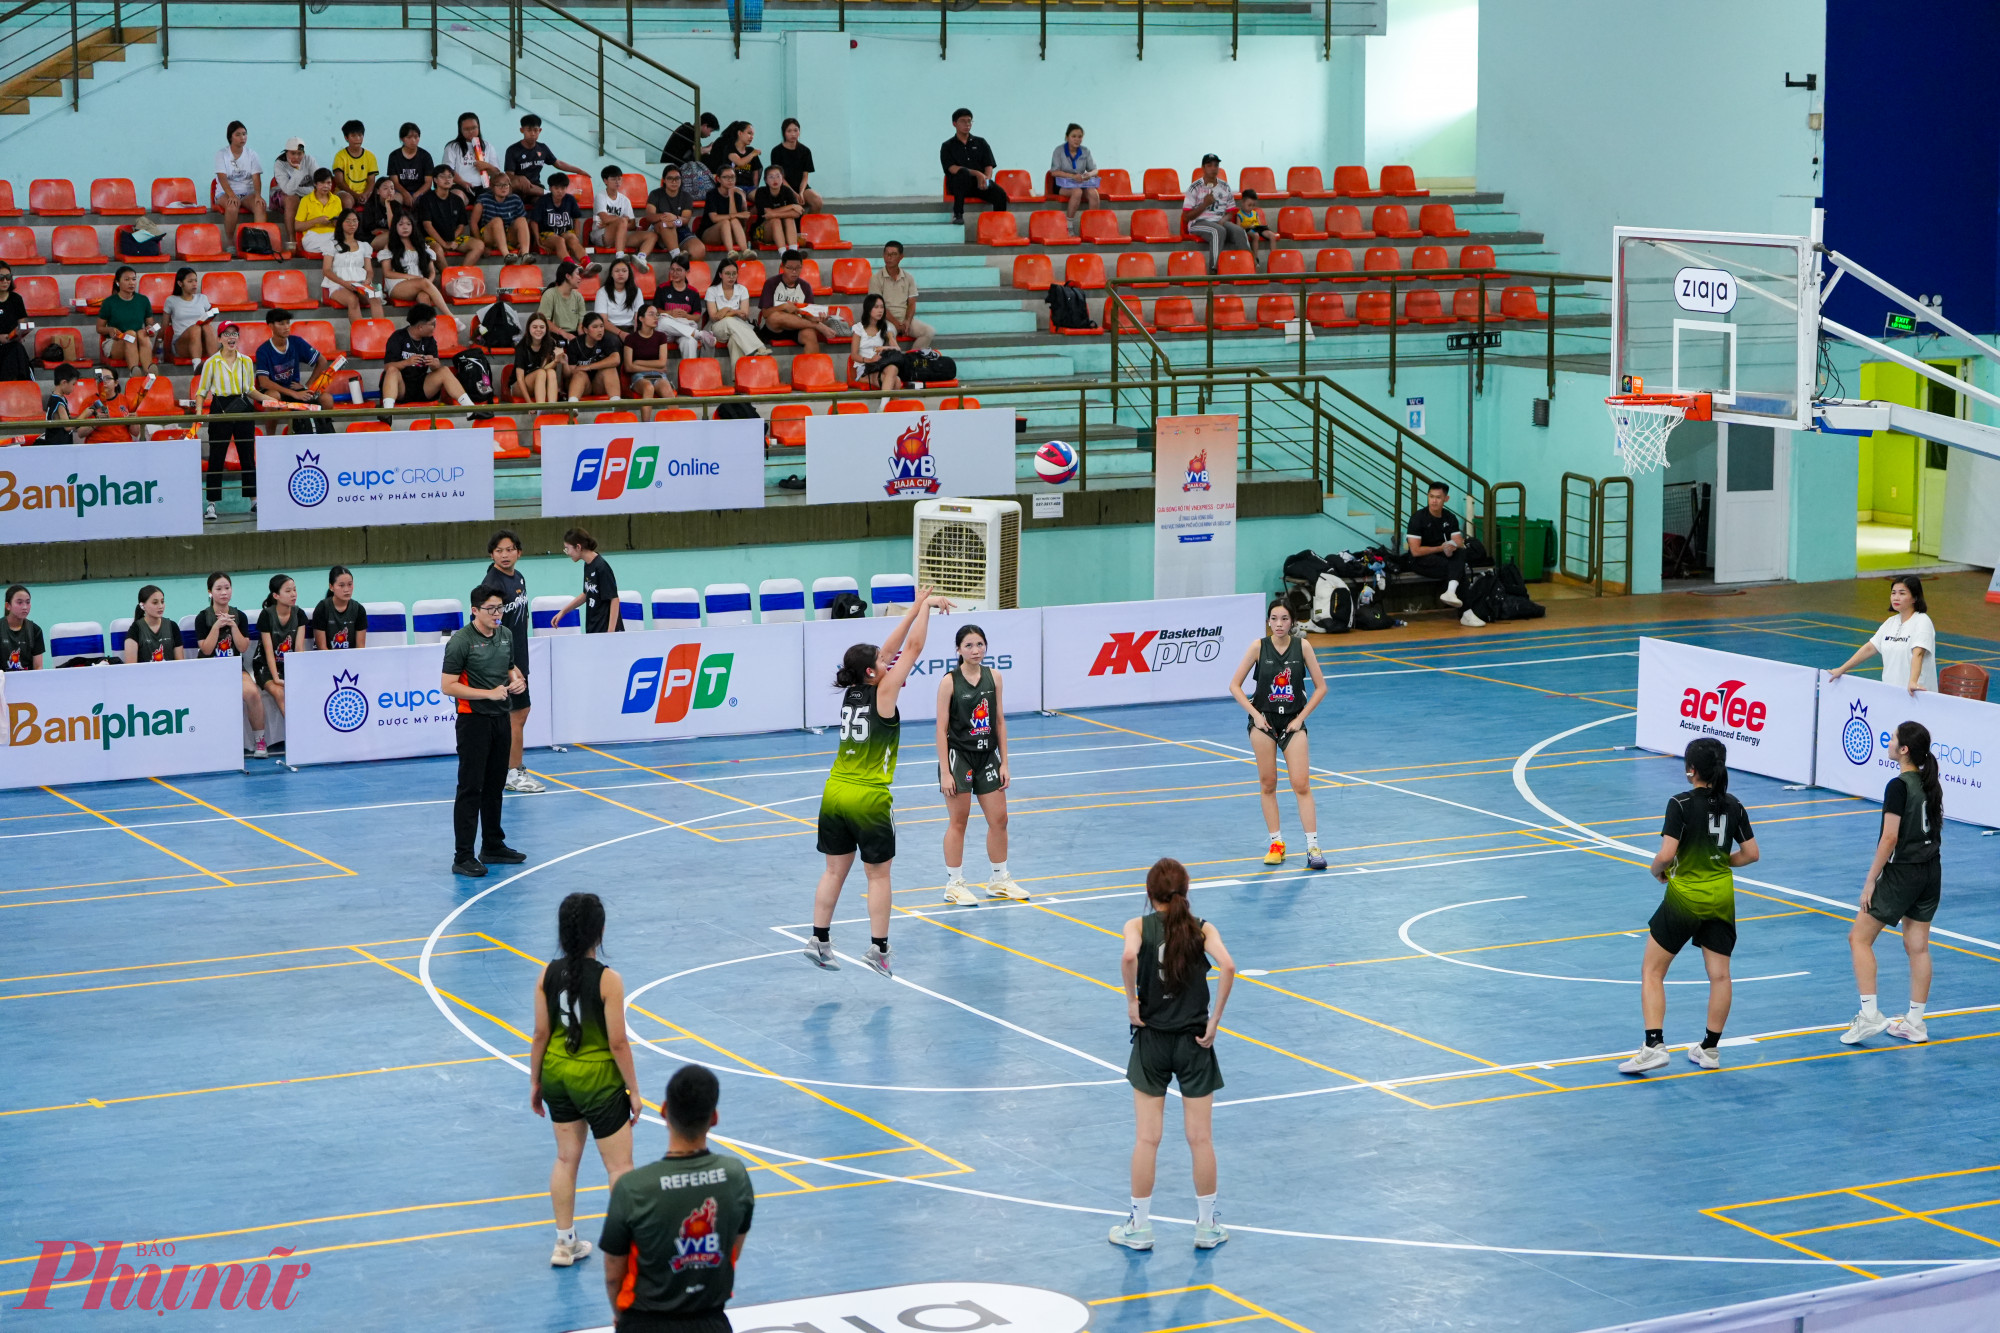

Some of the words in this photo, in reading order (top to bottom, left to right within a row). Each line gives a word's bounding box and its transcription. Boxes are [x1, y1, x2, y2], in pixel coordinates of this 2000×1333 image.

[548, 212, 571, 226] USA
[1895, 316, 1910, 324] EXIT
[668, 458, 720, 476] Online
[888, 454, 936, 479] VYB
[337, 469, 395, 490] eupc
[401, 466, 464, 484] GROUP
[893, 479, 916, 489] ZIAJA
[916, 479, 932, 487] CUP
[1185, 470, 1209, 483] VYB
[0, 470, 157, 518] Baniphar
[337, 495, 365, 503] DƯỢC
[370, 493, 384, 501] MỸ
[421, 490, 448, 499] CHÂU
[452, 489, 465, 497] ÂU
[1159, 625, 1223, 640] Basketball
[331, 640, 349, 649] VYB
[215, 649, 234, 657] VYB
[1088, 630, 1160, 677] AK
[1152, 639, 1221, 672] pro
[1270, 684, 1294, 695] VYB
[378, 689, 441, 711] eupc
[7, 702, 190, 751] Baniphar
[378, 717, 409, 726] DƯỢC
[414, 714, 429, 724] MỸ
[1680, 719, 1701, 732] Active
[1702, 724, 1735, 740] Enhanced
[1736, 731, 1761, 747] Energy
[977, 739, 989, 750] 24
[985, 769, 999, 782] 24
[1944, 773, 1967, 786] CHÂU
[1970, 776, 1982, 789] ÂU
[1708, 812, 1727, 847] 4
[660, 1167, 727, 1191] REFEREE
[674, 1233, 719, 1256] VYB
[701, 1254, 715, 1262] CUP
